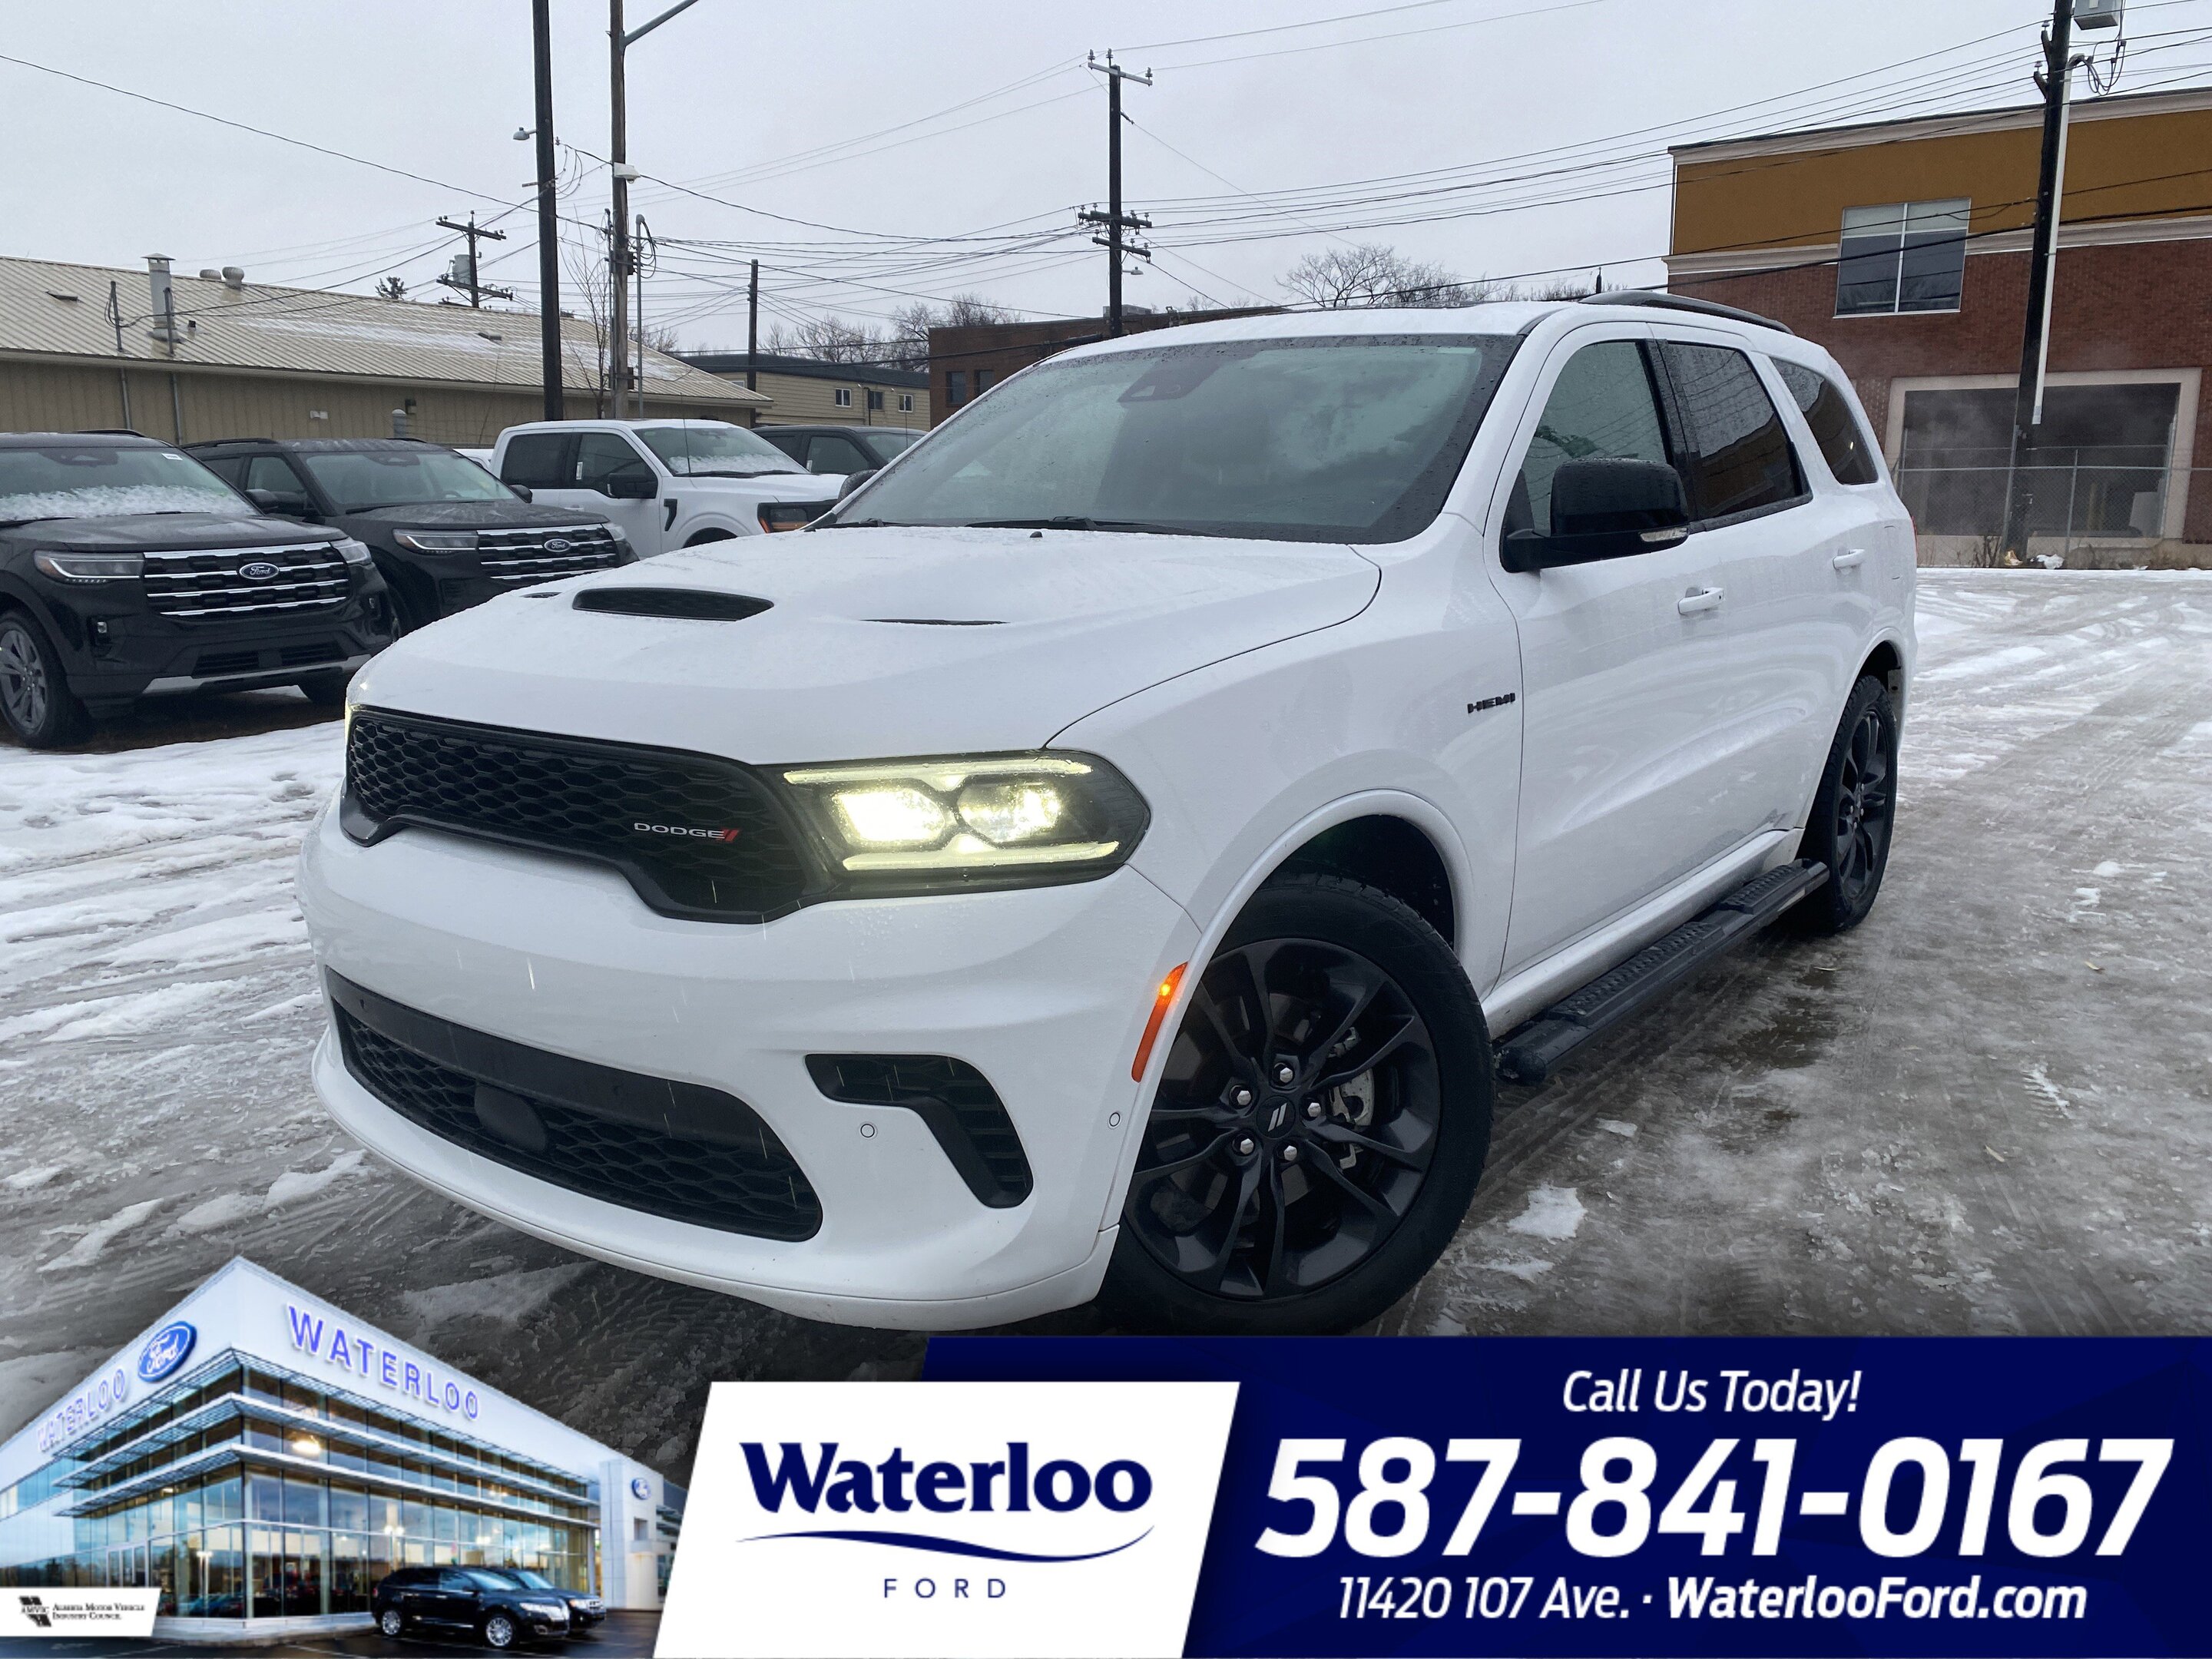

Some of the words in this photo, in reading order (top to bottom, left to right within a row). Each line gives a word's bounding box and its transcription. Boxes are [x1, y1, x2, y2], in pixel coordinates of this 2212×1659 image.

[250, 565, 270, 575] Ford
[1467, 693, 1515, 714] HEMI
[634, 822, 726, 839] DODGE
